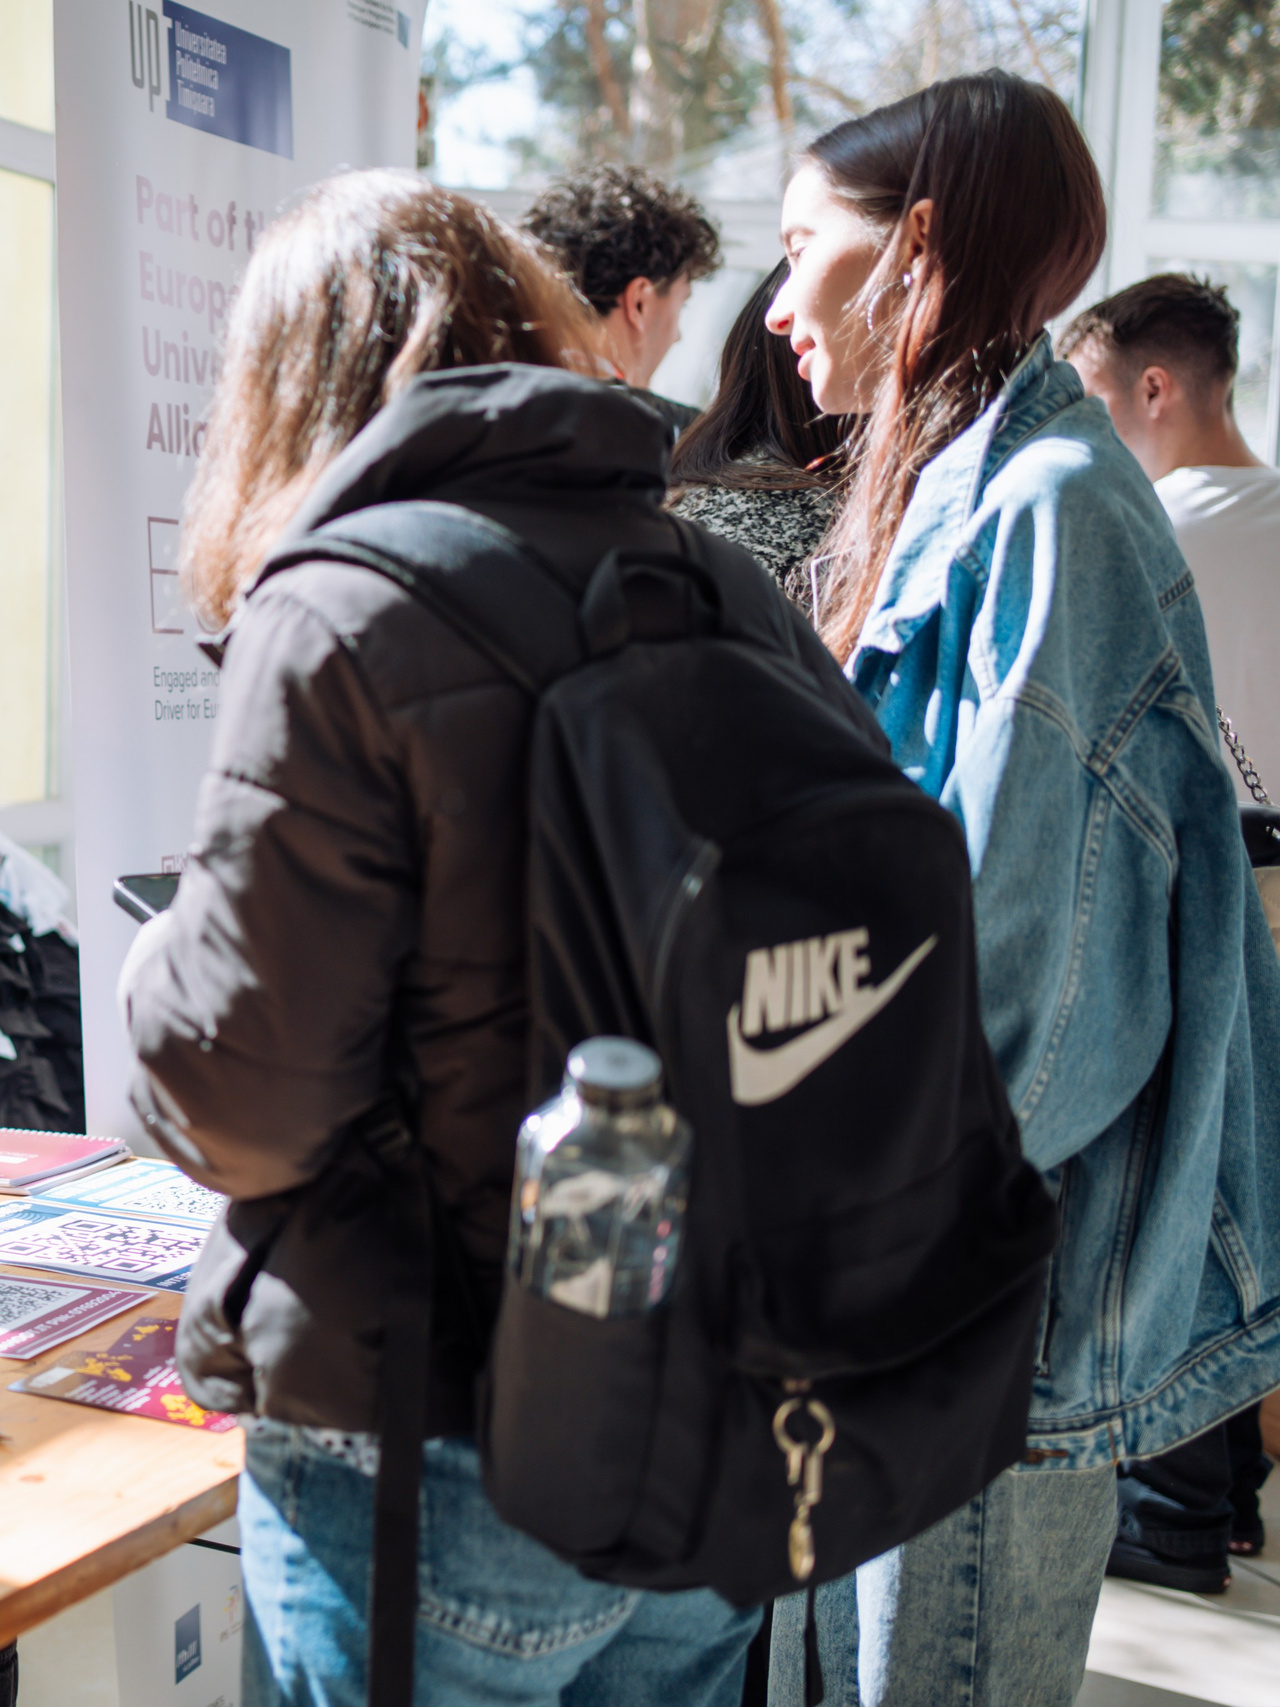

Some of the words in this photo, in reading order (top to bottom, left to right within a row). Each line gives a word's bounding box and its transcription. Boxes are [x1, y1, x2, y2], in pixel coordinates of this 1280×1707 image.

[174, 19, 227, 65] Universitatea
[175, 49, 219, 90] Politehnica
[136, 174, 199, 242] Part
[207, 201, 237, 251] of
[139, 250, 240, 335] Europ
[142, 325, 223, 387] Univ
[153, 665, 198, 693] Engaged
[155, 699, 184, 720] Driver
[187, 698, 200, 719] for
[204, 698, 220, 719] Eu
[741, 925, 872, 1039] NIKE
